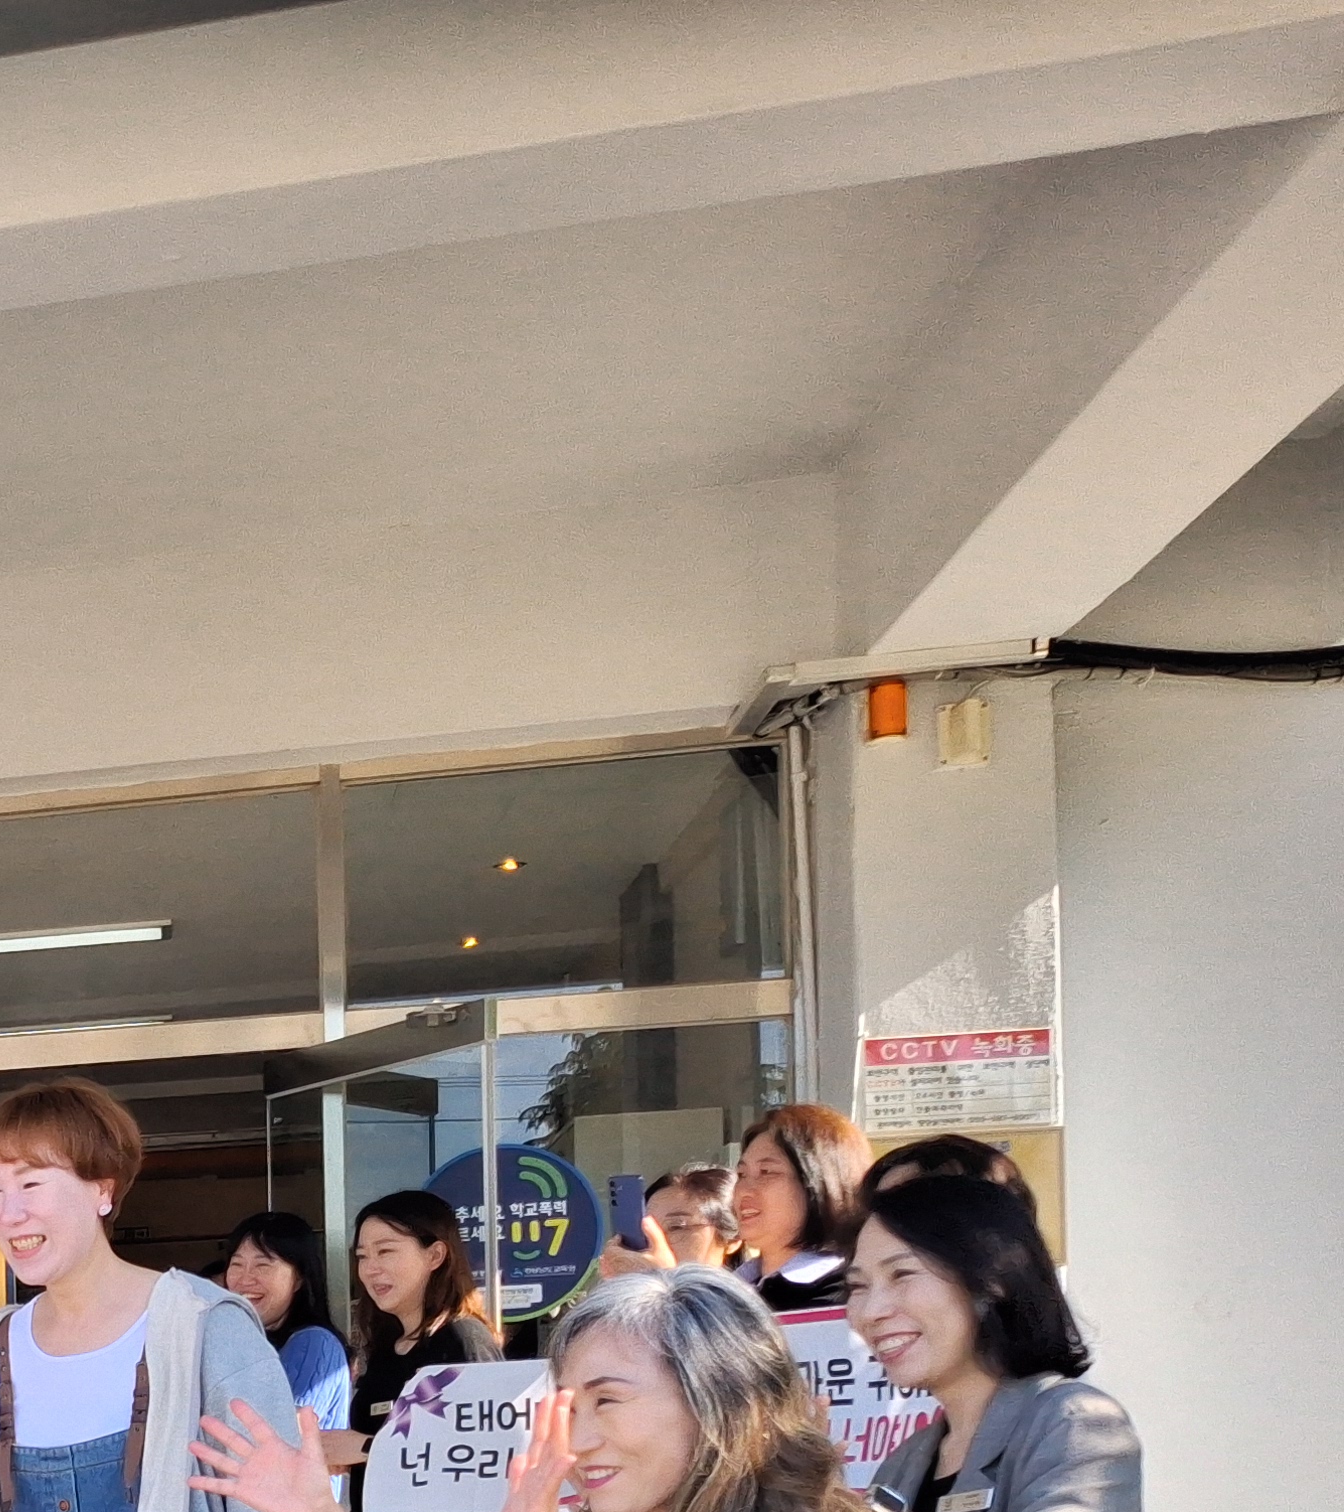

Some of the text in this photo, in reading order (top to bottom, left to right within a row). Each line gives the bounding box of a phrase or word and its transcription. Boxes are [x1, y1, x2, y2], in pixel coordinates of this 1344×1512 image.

[879, 1034, 1036, 1060] CCTV 녹화중
[509, 1200, 568, 1218] 학교폭력
[455, 1397, 538, 1432] 태어
[400, 1442, 514, 1487] 넌 우리
